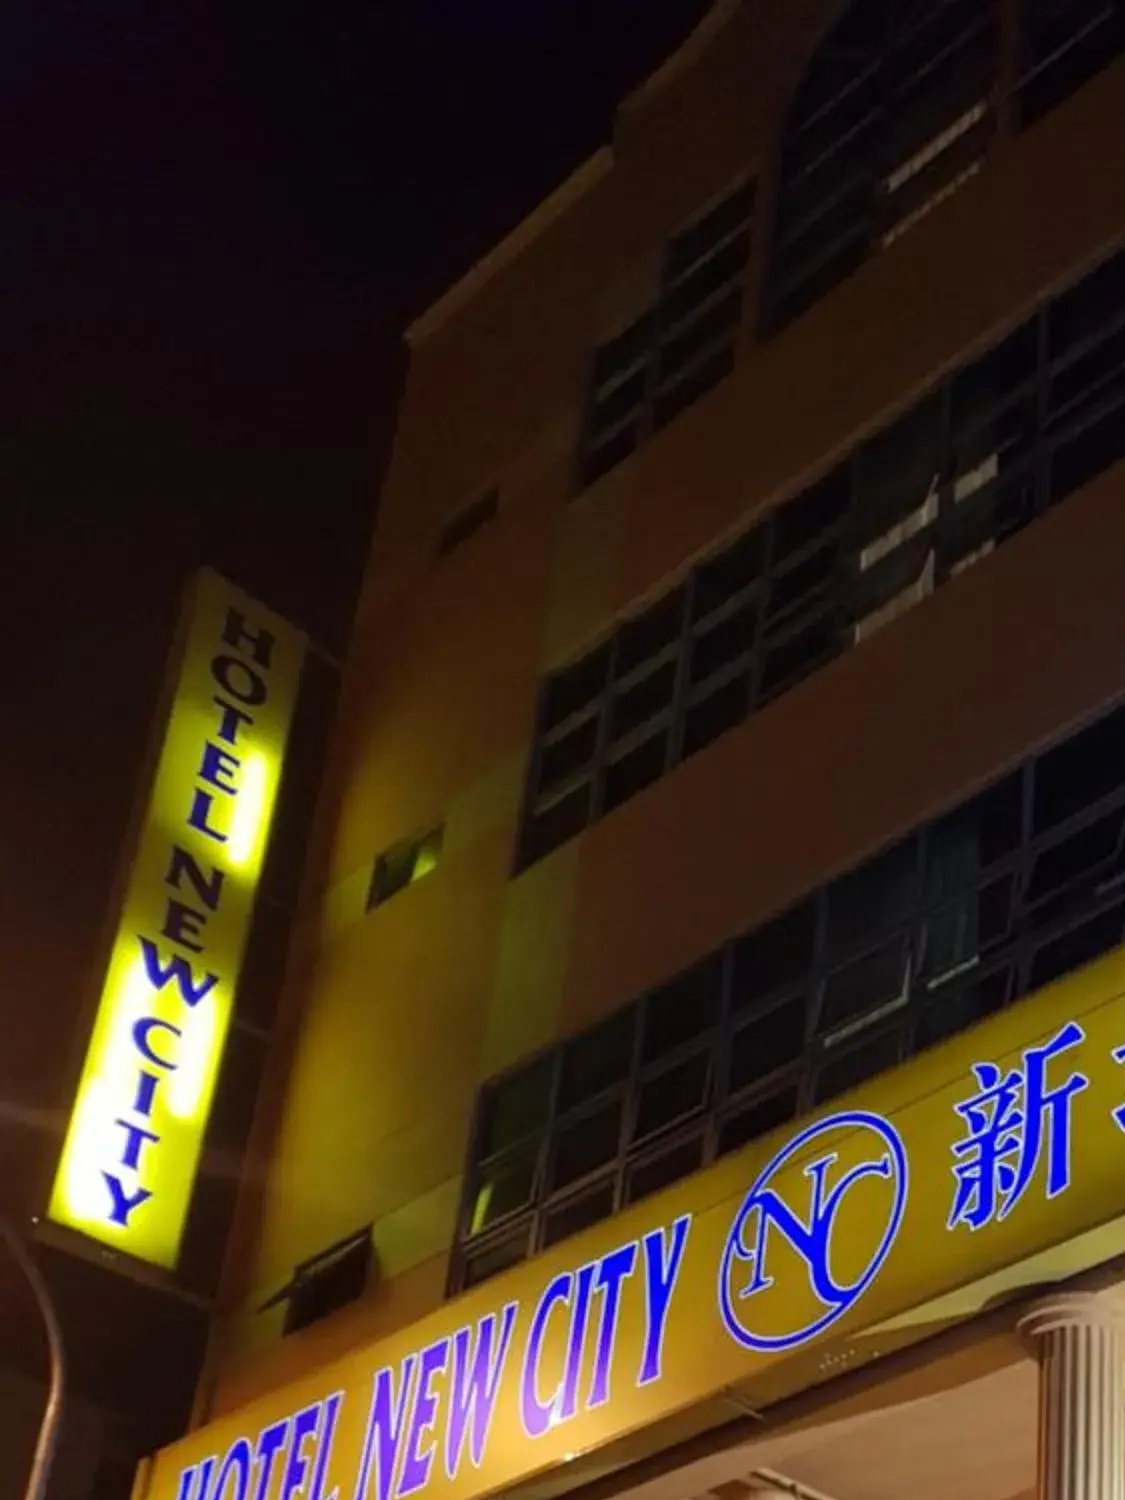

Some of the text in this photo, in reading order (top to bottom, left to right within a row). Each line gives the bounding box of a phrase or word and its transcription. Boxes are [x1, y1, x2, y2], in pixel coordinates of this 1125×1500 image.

[101, 607, 275, 1228] HOTEL NEW CITY
[518, 1213, 693, 1440] CITY
